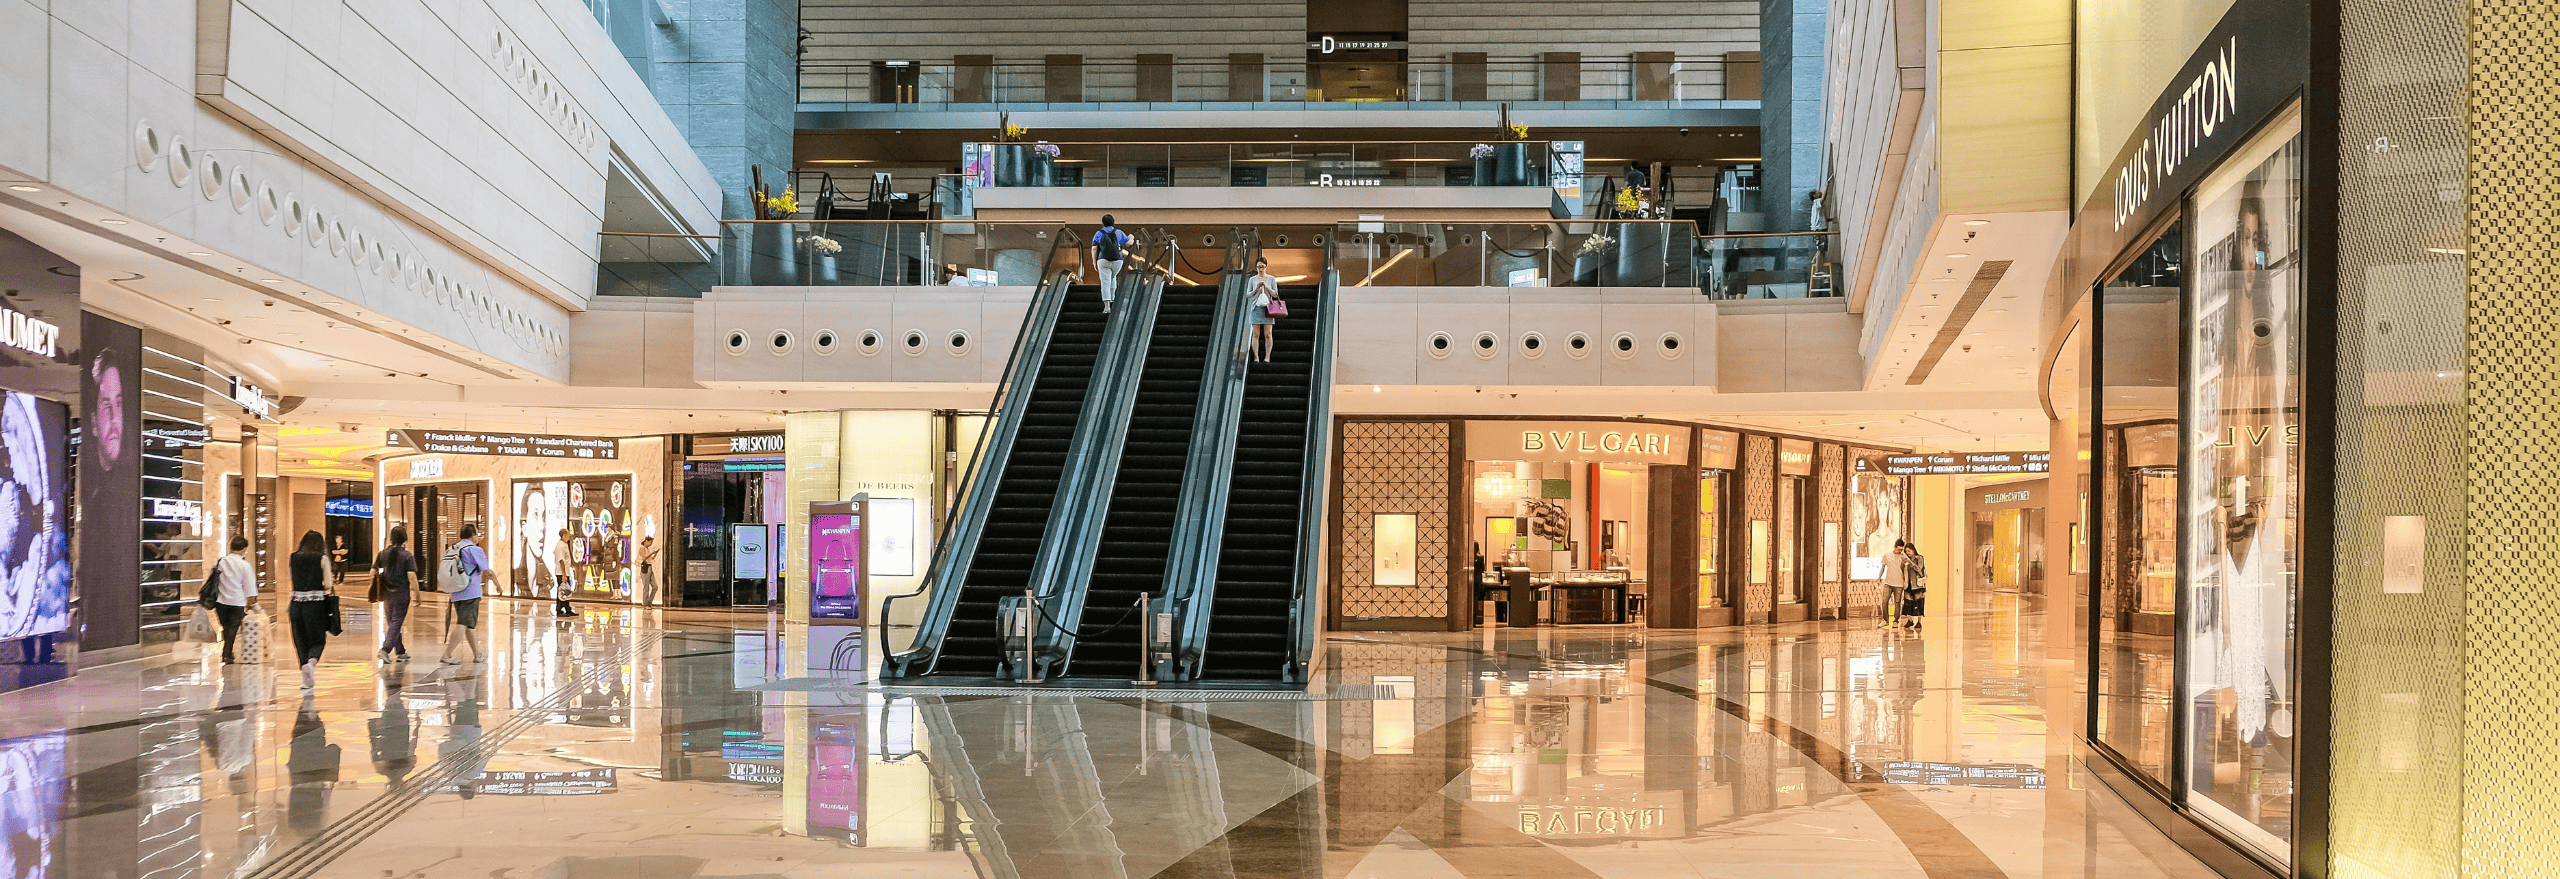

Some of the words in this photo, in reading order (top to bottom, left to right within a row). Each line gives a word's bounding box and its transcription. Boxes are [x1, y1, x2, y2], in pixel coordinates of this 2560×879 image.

[1322, 36, 1335, 54] D
[2114, 137, 2149, 233] LOUIS
[2154, 35, 2236, 190] VUITTON
[1320, 174, 1333, 188] R
[432, 433, 454, 441] Franck
[455, 434, 477, 442] Muller
[487, 436, 511, 444] Mango
[511, 436, 525, 444] Tree
[536, 437, 565, 446] Standard
[566, 438, 597, 447] Chartered
[751, 435, 784, 451] SKY100
[1522, 430, 1671, 456] BVLGARI
[458, 445, 489, 453] Gabbana
[542, 448, 565, 456] Corum
